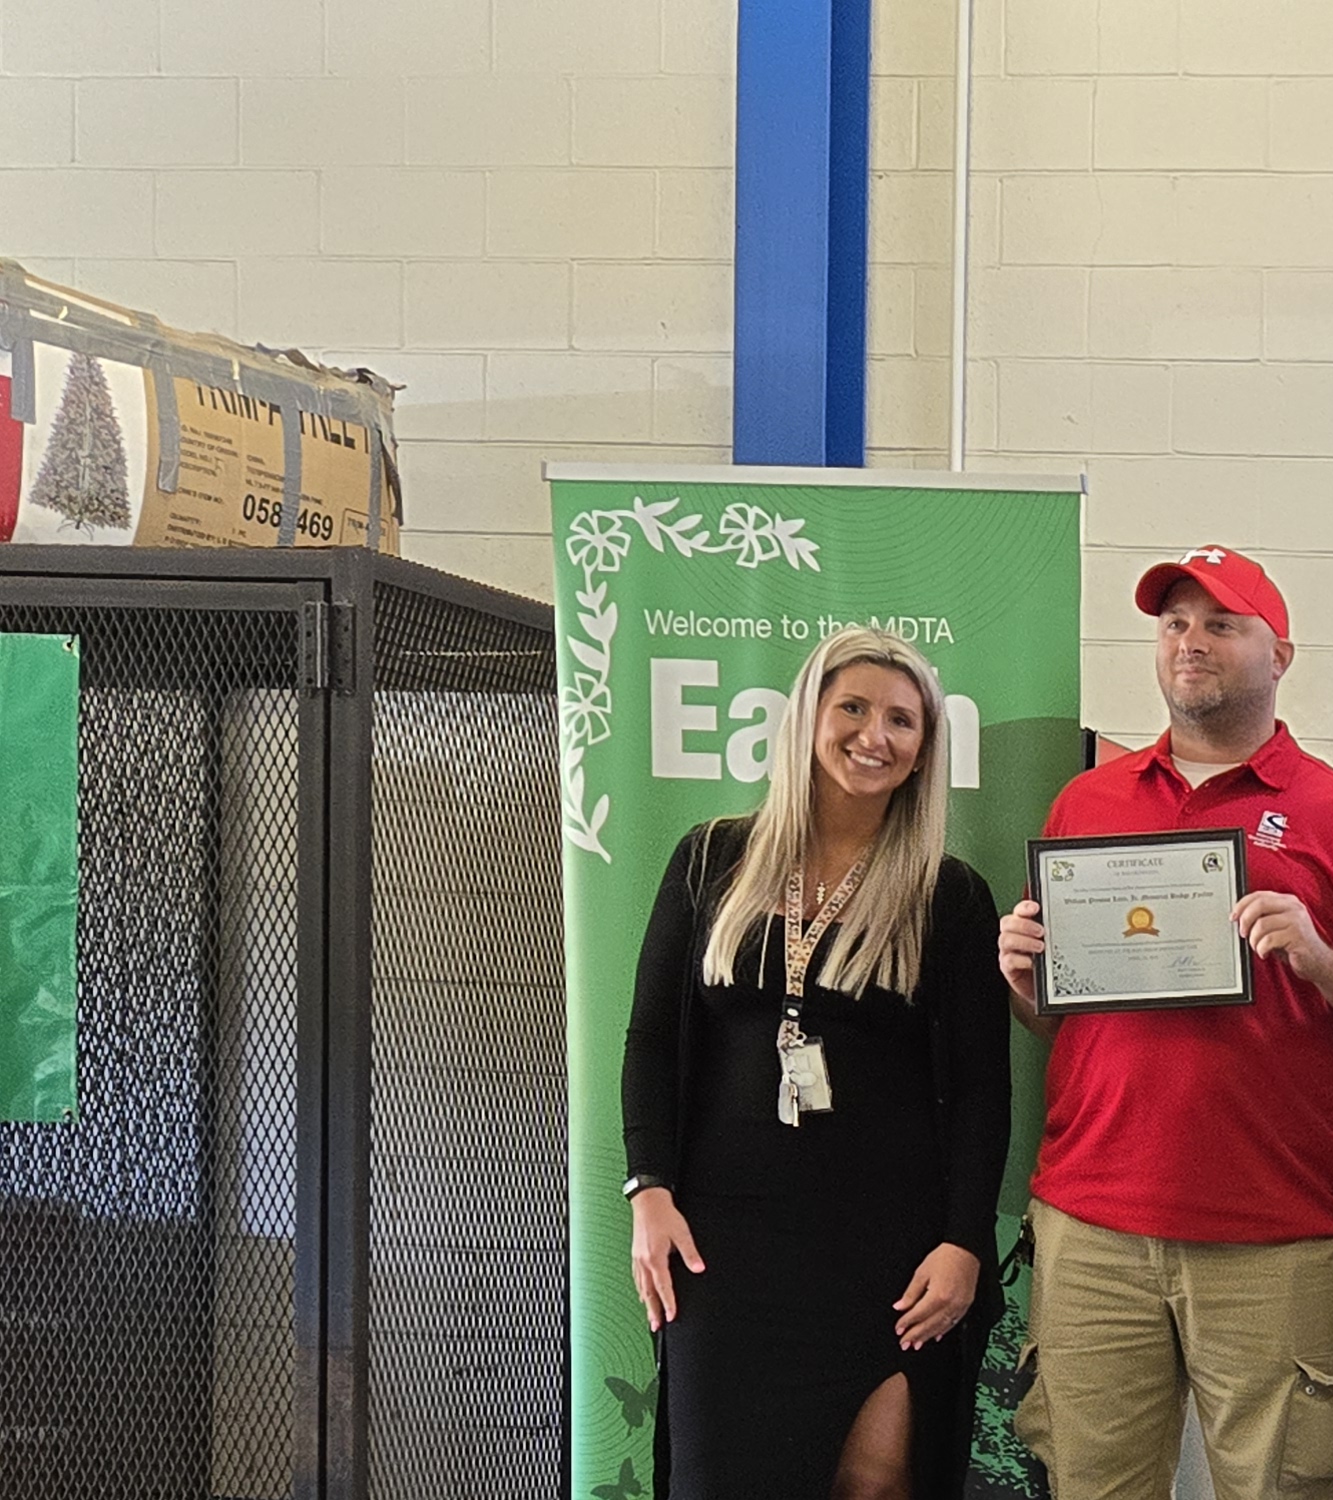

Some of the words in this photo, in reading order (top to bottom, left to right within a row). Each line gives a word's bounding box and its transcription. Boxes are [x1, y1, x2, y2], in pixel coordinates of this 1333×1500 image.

[242, 494, 333, 541] 058469
[644, 609, 772, 639] Welcome
[781, 614, 809, 640] to
[817, 614, 859, 639] th
[871, 616, 955, 644] MDTA
[650, 657, 980, 789] Eah
[1107, 857, 1164, 869] CERTIFICATE
